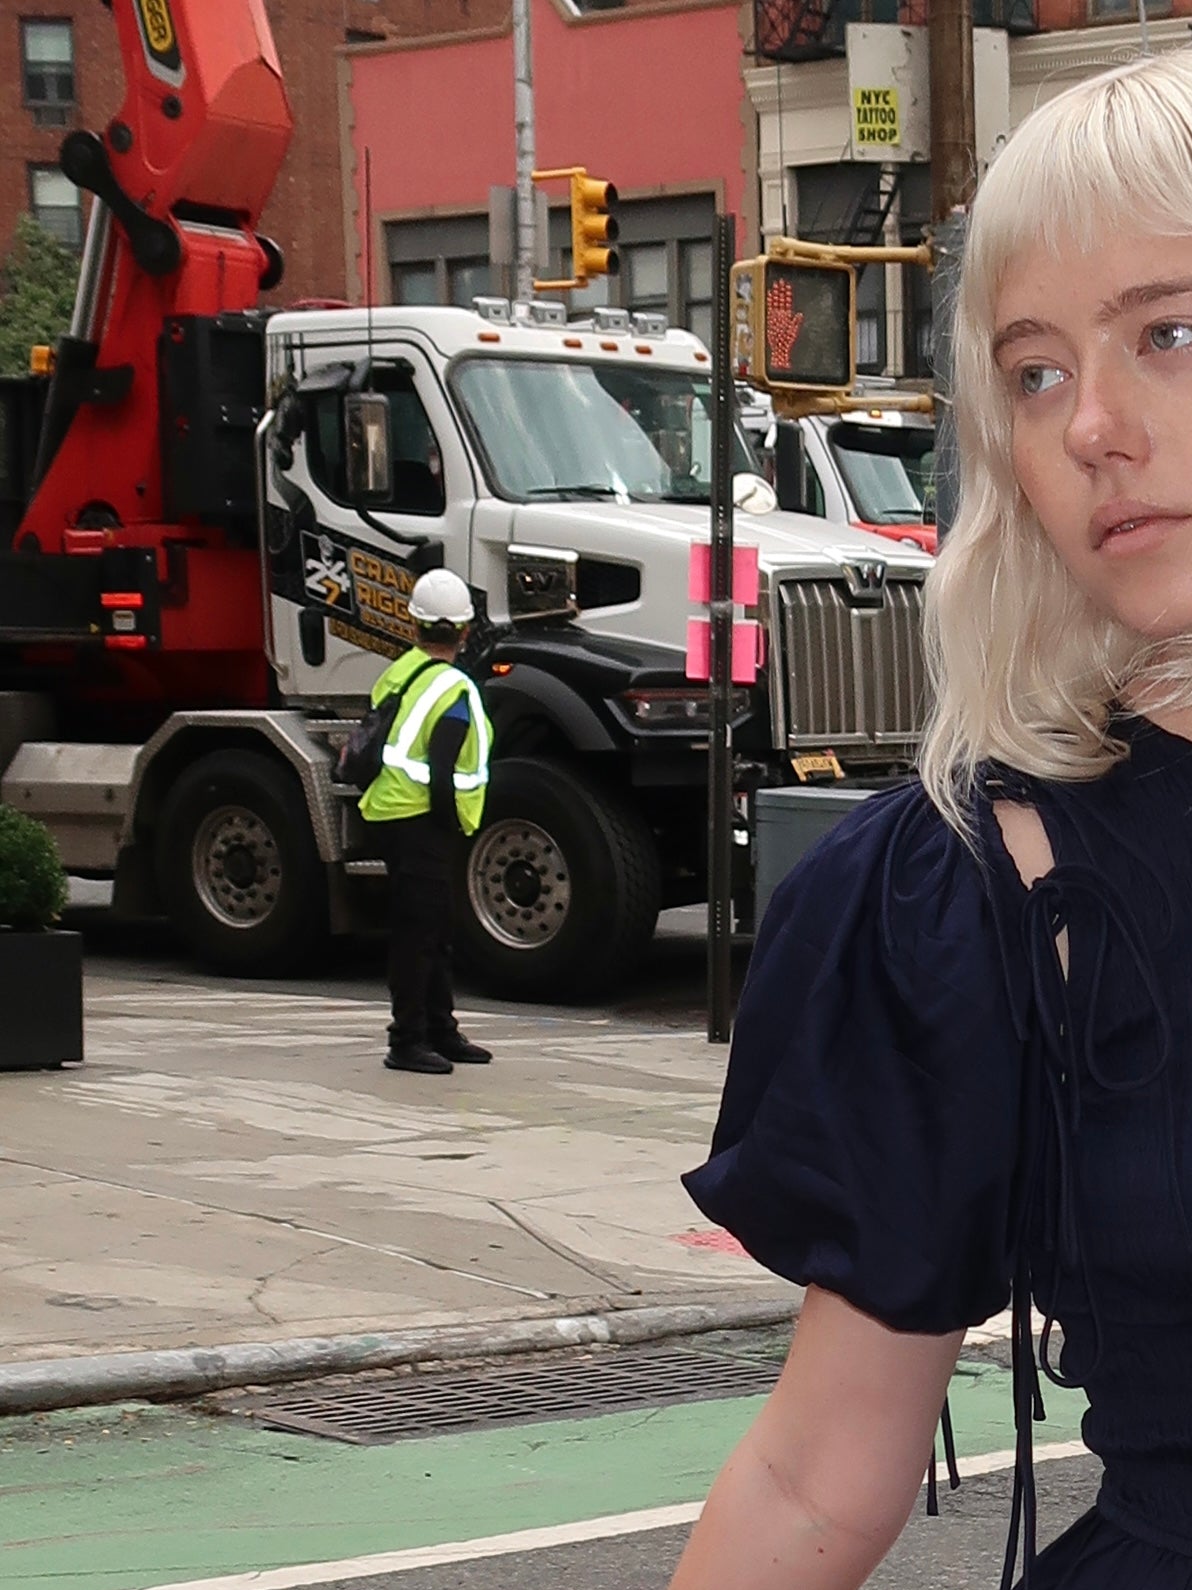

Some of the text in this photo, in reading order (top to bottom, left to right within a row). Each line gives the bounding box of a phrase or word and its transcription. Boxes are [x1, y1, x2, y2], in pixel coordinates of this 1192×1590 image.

[861, 89, 890, 105] NYC
[856, 107, 896, 124] TATTOO
[858, 127, 897, 142] SHOP
[351, 550, 416, 596] CRAN
[355, 579, 413, 622] RIGG
